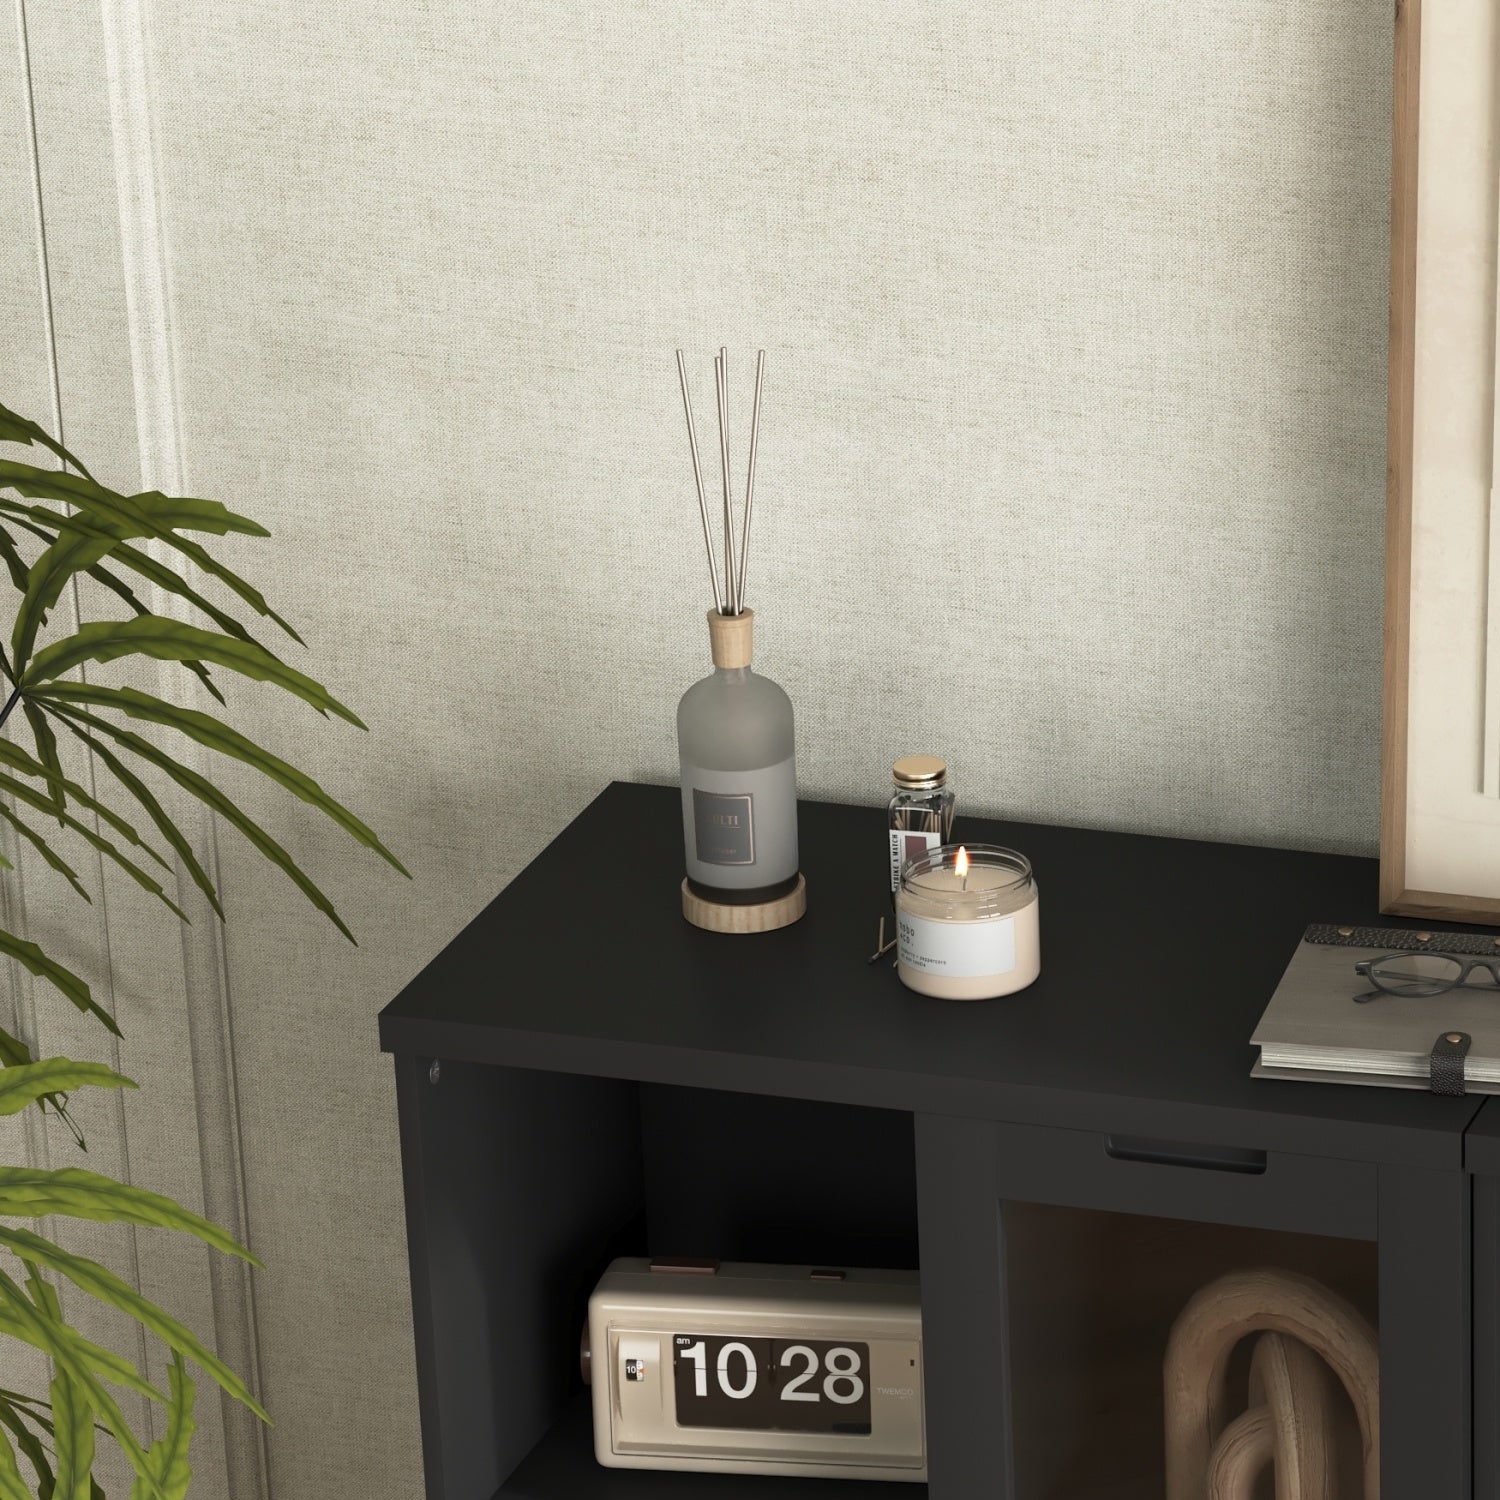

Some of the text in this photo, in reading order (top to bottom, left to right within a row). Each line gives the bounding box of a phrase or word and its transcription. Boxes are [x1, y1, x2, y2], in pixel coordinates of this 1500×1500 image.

[676, 1337, 690, 1345] am
[626, 1365, 636, 1374] 10
[680, 1341, 864, 1405] 10 28
